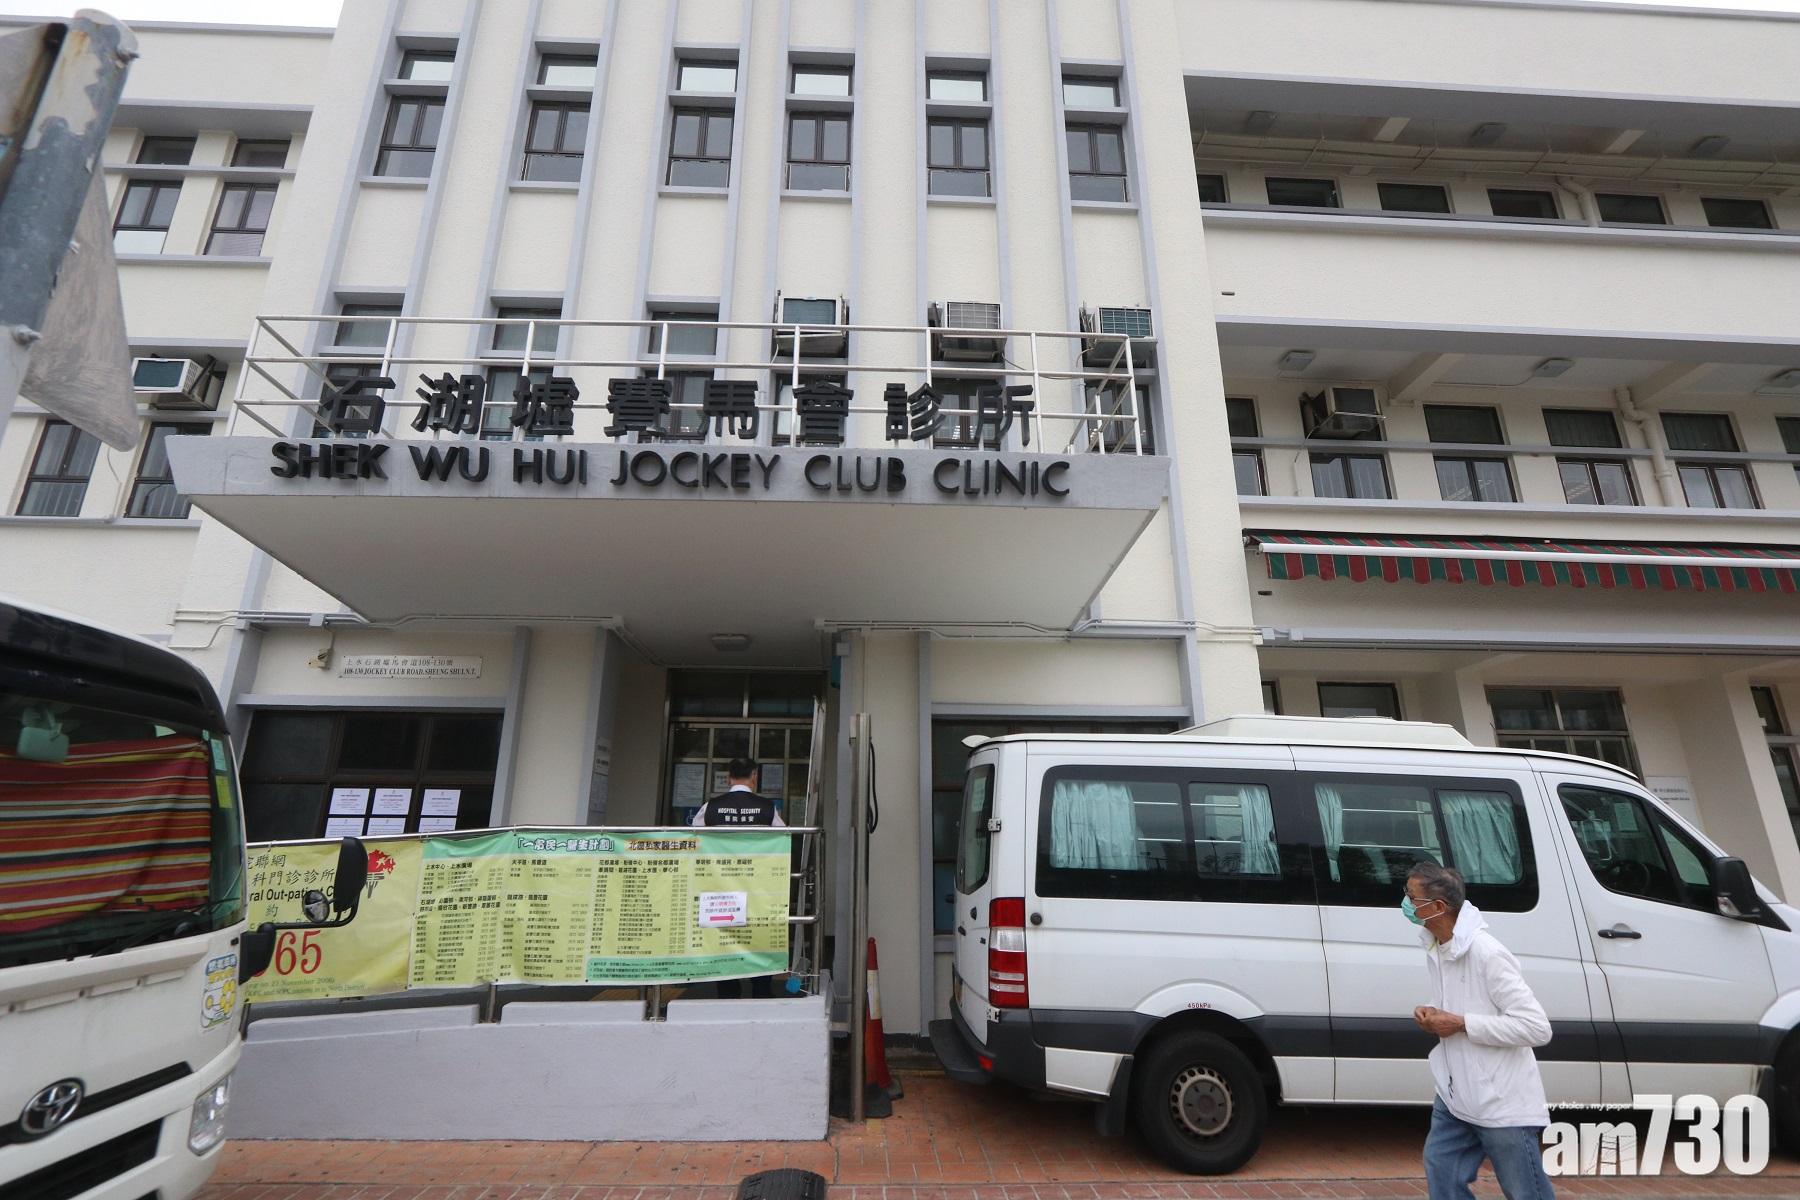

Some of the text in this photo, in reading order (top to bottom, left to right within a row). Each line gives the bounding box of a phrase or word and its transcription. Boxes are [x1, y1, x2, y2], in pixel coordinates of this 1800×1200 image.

[323, 372, 1035, 446] 石湖墟賽馬會診所
[271, 441, 1070, 497] SHEK WU HUI JOCKEY CLUB CLINIC
[717, 807, 761, 815] HOSPITAL SECURITY
[252, 868, 335, 886] 科門診診所
